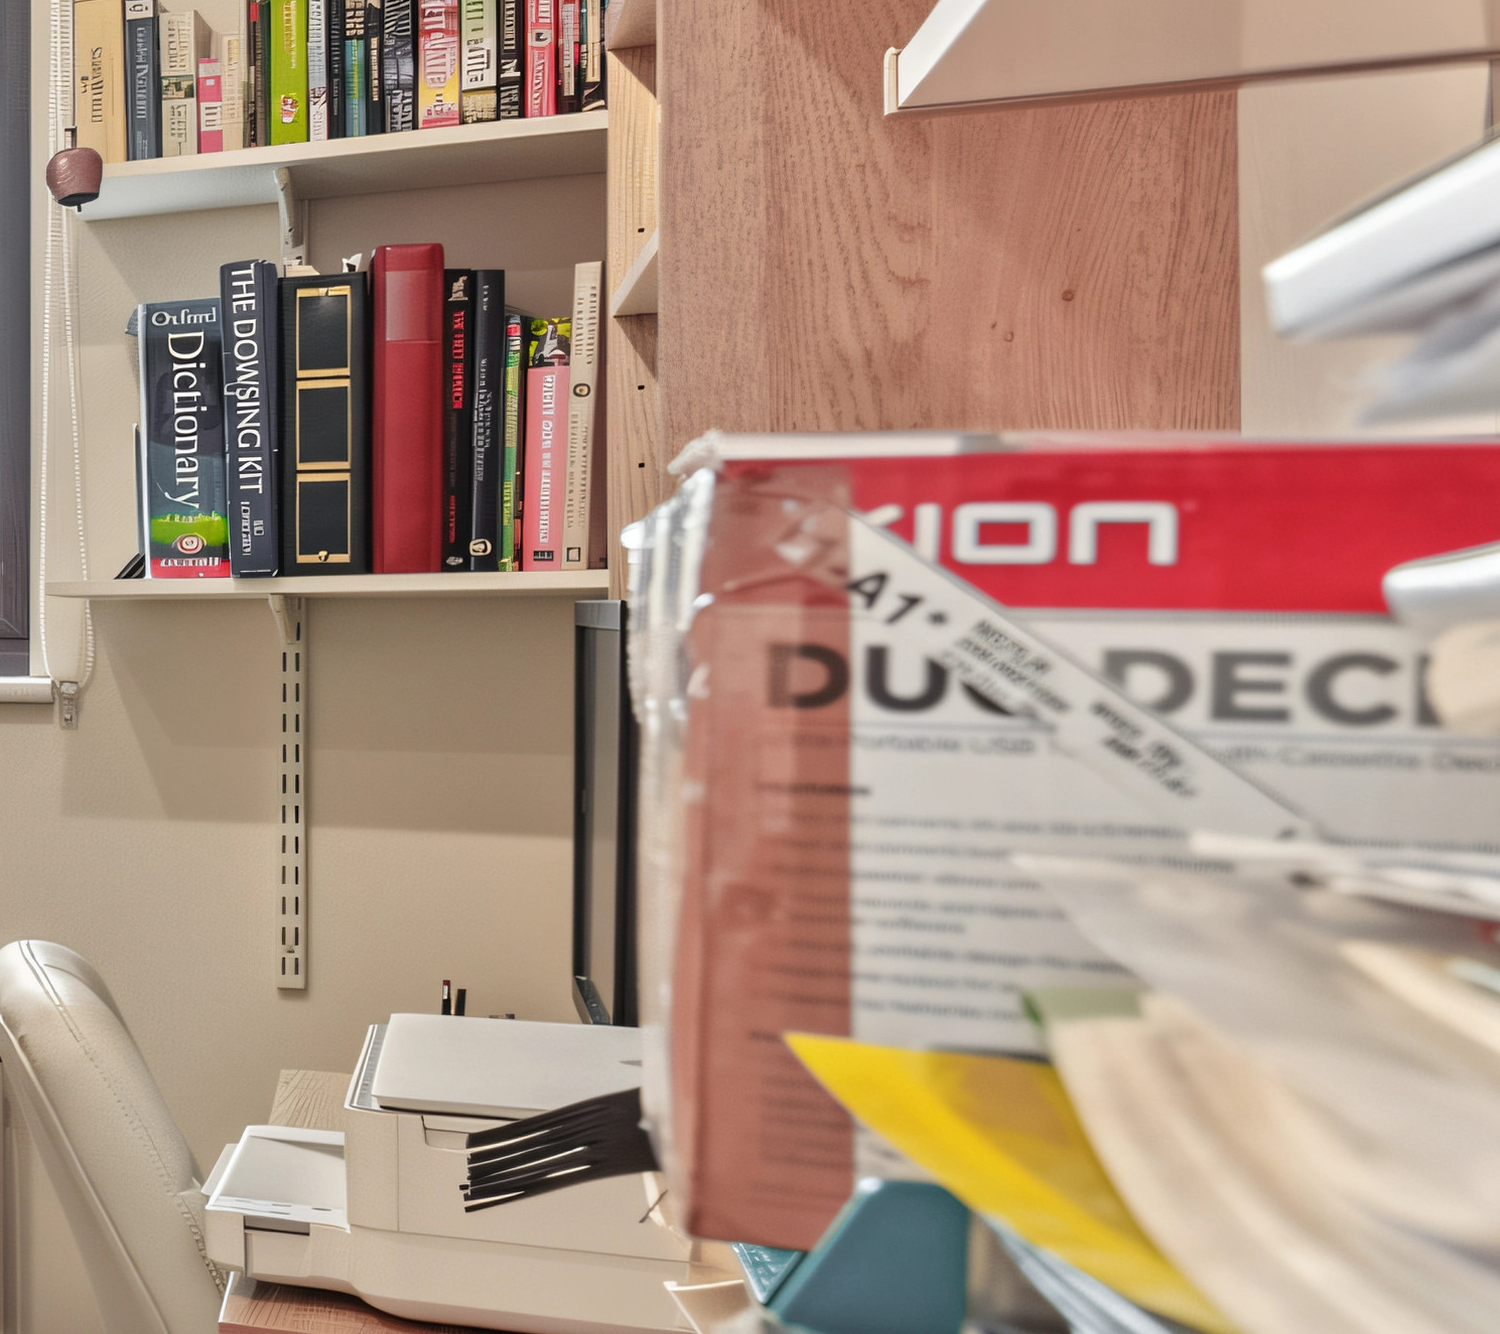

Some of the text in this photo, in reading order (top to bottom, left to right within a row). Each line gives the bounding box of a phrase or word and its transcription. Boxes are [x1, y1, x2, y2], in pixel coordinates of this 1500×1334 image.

[231, 264, 256, 314] THE
[162, 329, 207, 509] Dictionary
[233, 318, 261, 449] DOWSING
[238, 455, 263, 495] KIT
[767, 641, 1015, 717] DU
